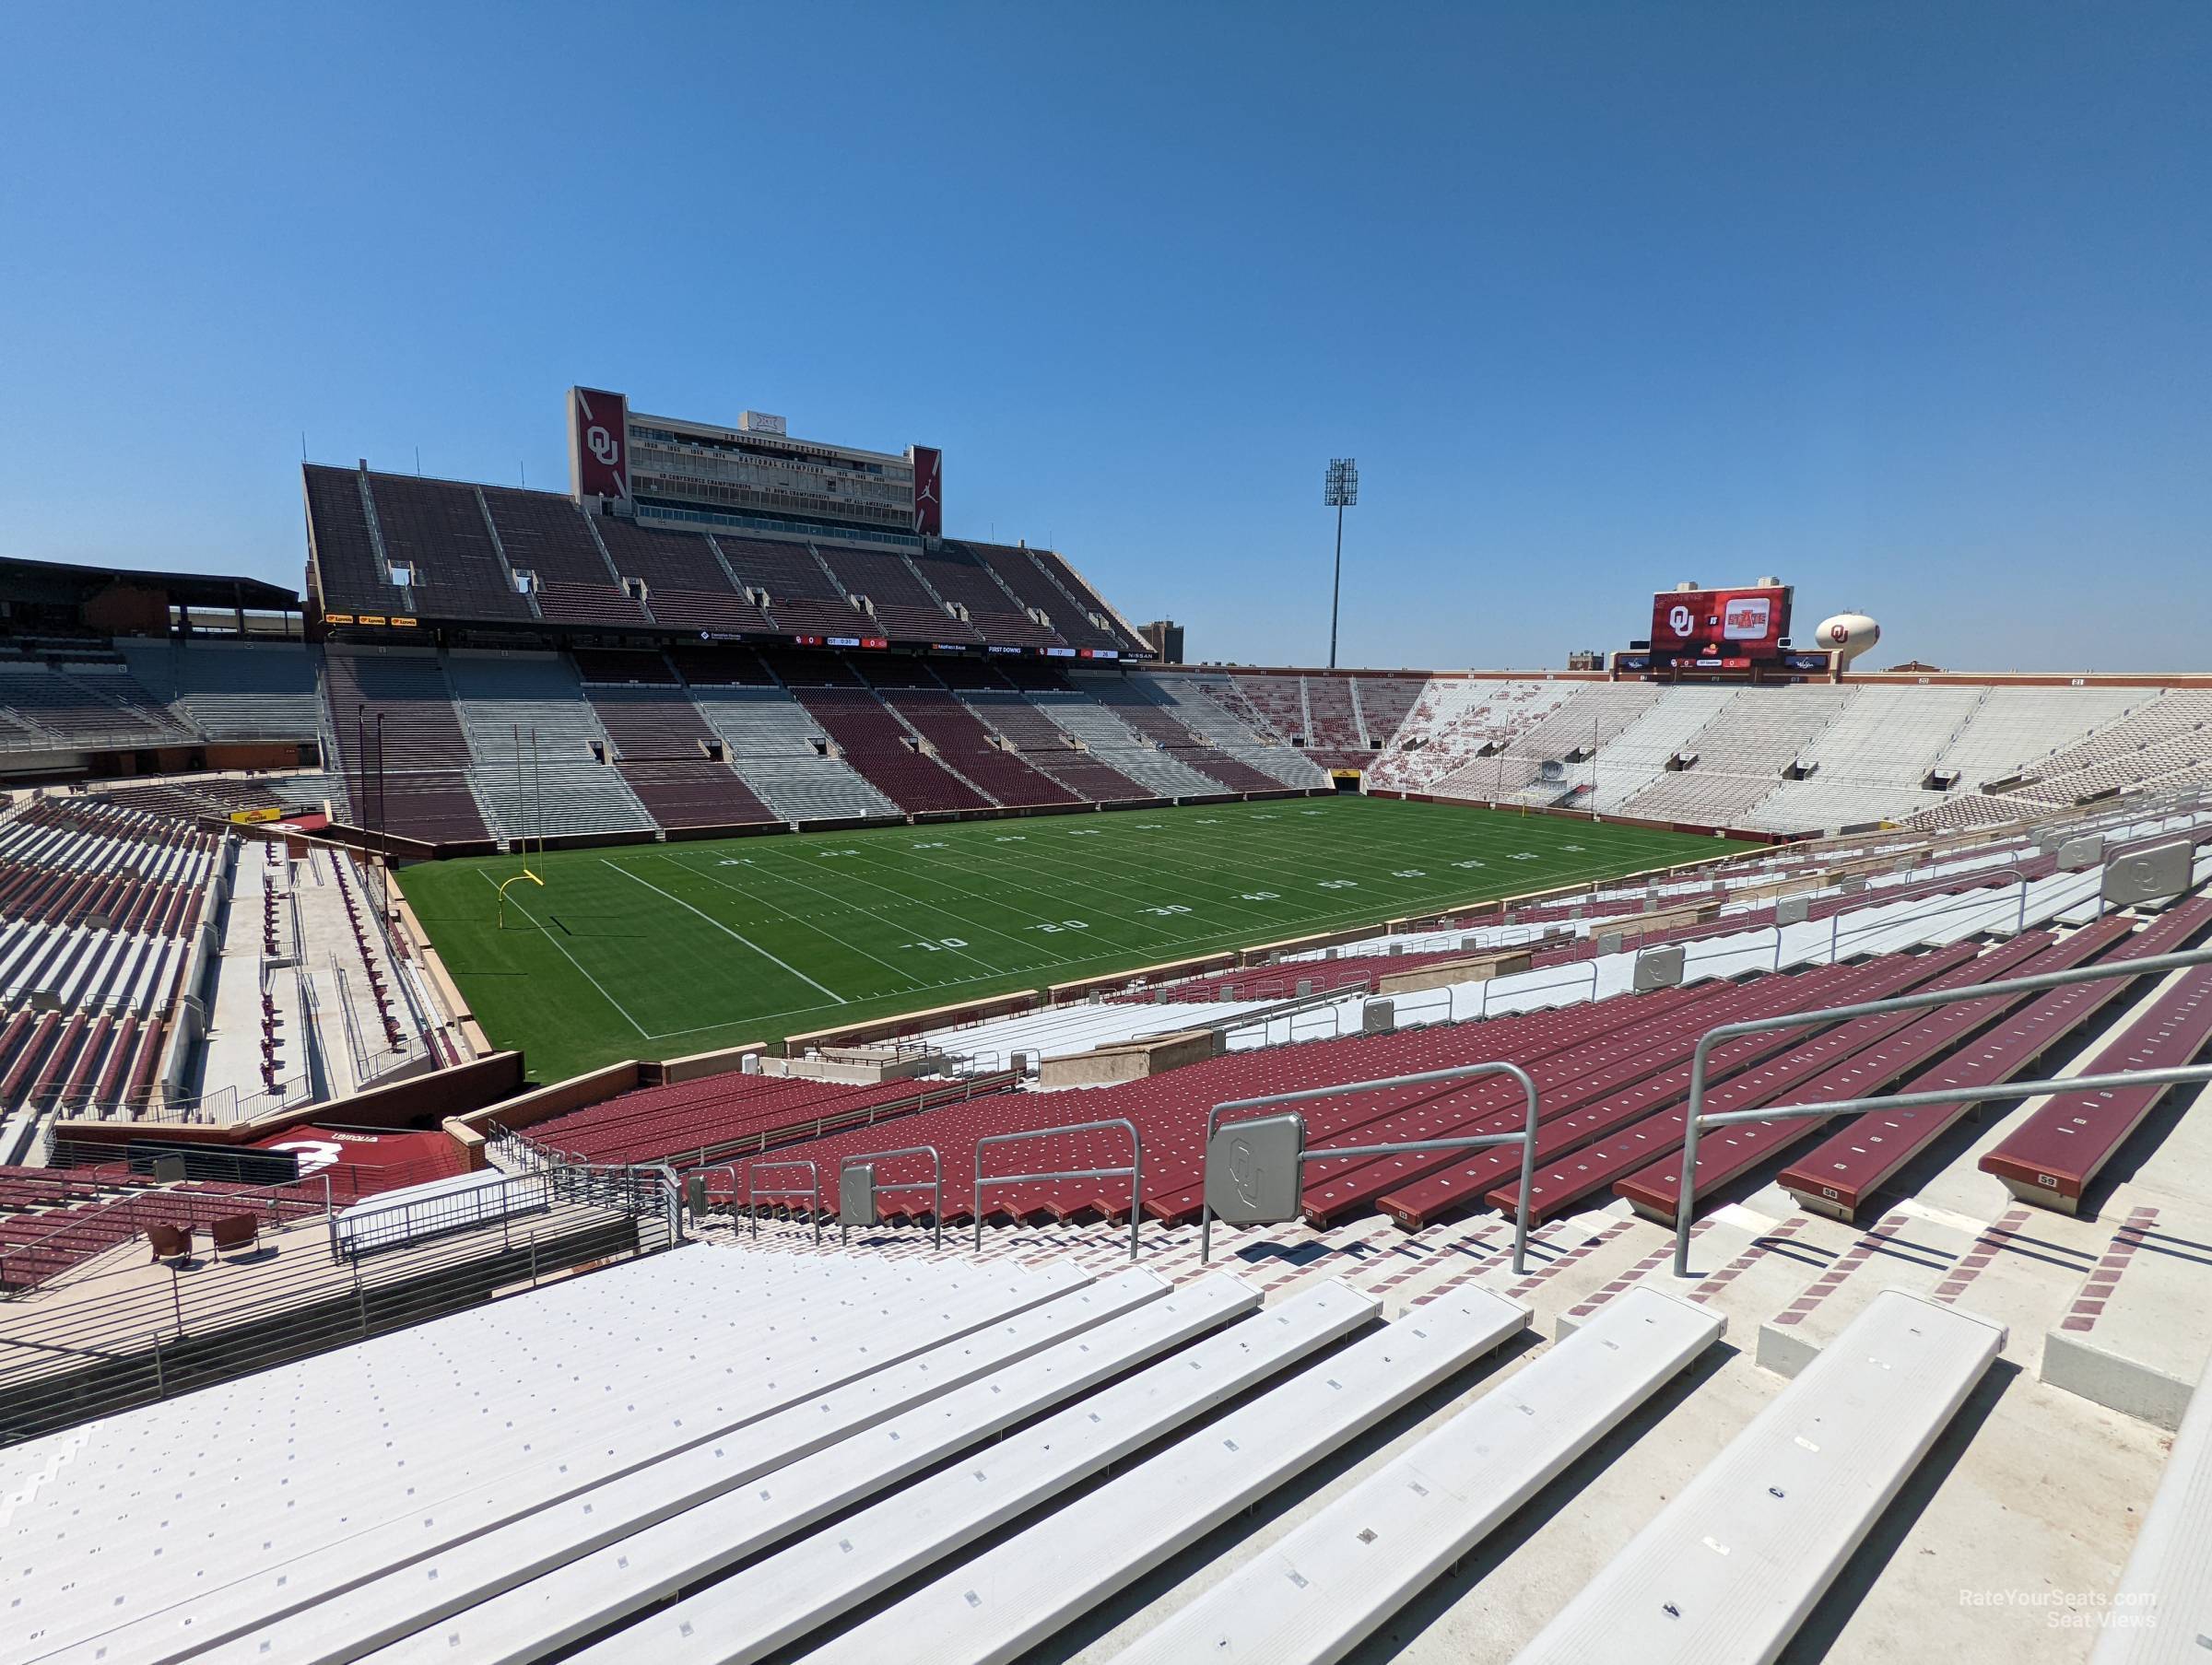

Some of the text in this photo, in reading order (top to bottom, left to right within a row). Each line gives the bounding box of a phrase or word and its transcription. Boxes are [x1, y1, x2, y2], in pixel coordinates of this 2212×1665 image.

[588, 426, 618, 464] OU
[725, 434, 777, 447] UNIVERSITY
[796, 445, 838, 457] OKLAHOMA
[739, 456, 777, 467] NATIONAL
[782, 462, 824, 474] CHAMPIONS
[669, 474, 705, 484] CONFERENCE
[707, 479, 751, 490] CHAMPIONSHIPS
[789, 490, 830, 499] CHAMPIONSHIPS
[1669, 605, 1694, 637] OU
[1831, 625, 1848, 643] OU
[1317, 880, 1358, 888] 50
[1241, 891, 1280, 900] 40
[1146, 905, 1192, 916] 30
[1037, 920, 1088, 932] 20
[917, 938, 968, 951] 10
[2041, 1175, 2054, 1186] 59
[1825, 1188, 1836, 1197] 58
[1769, 1487, 1784, 1498] 3
